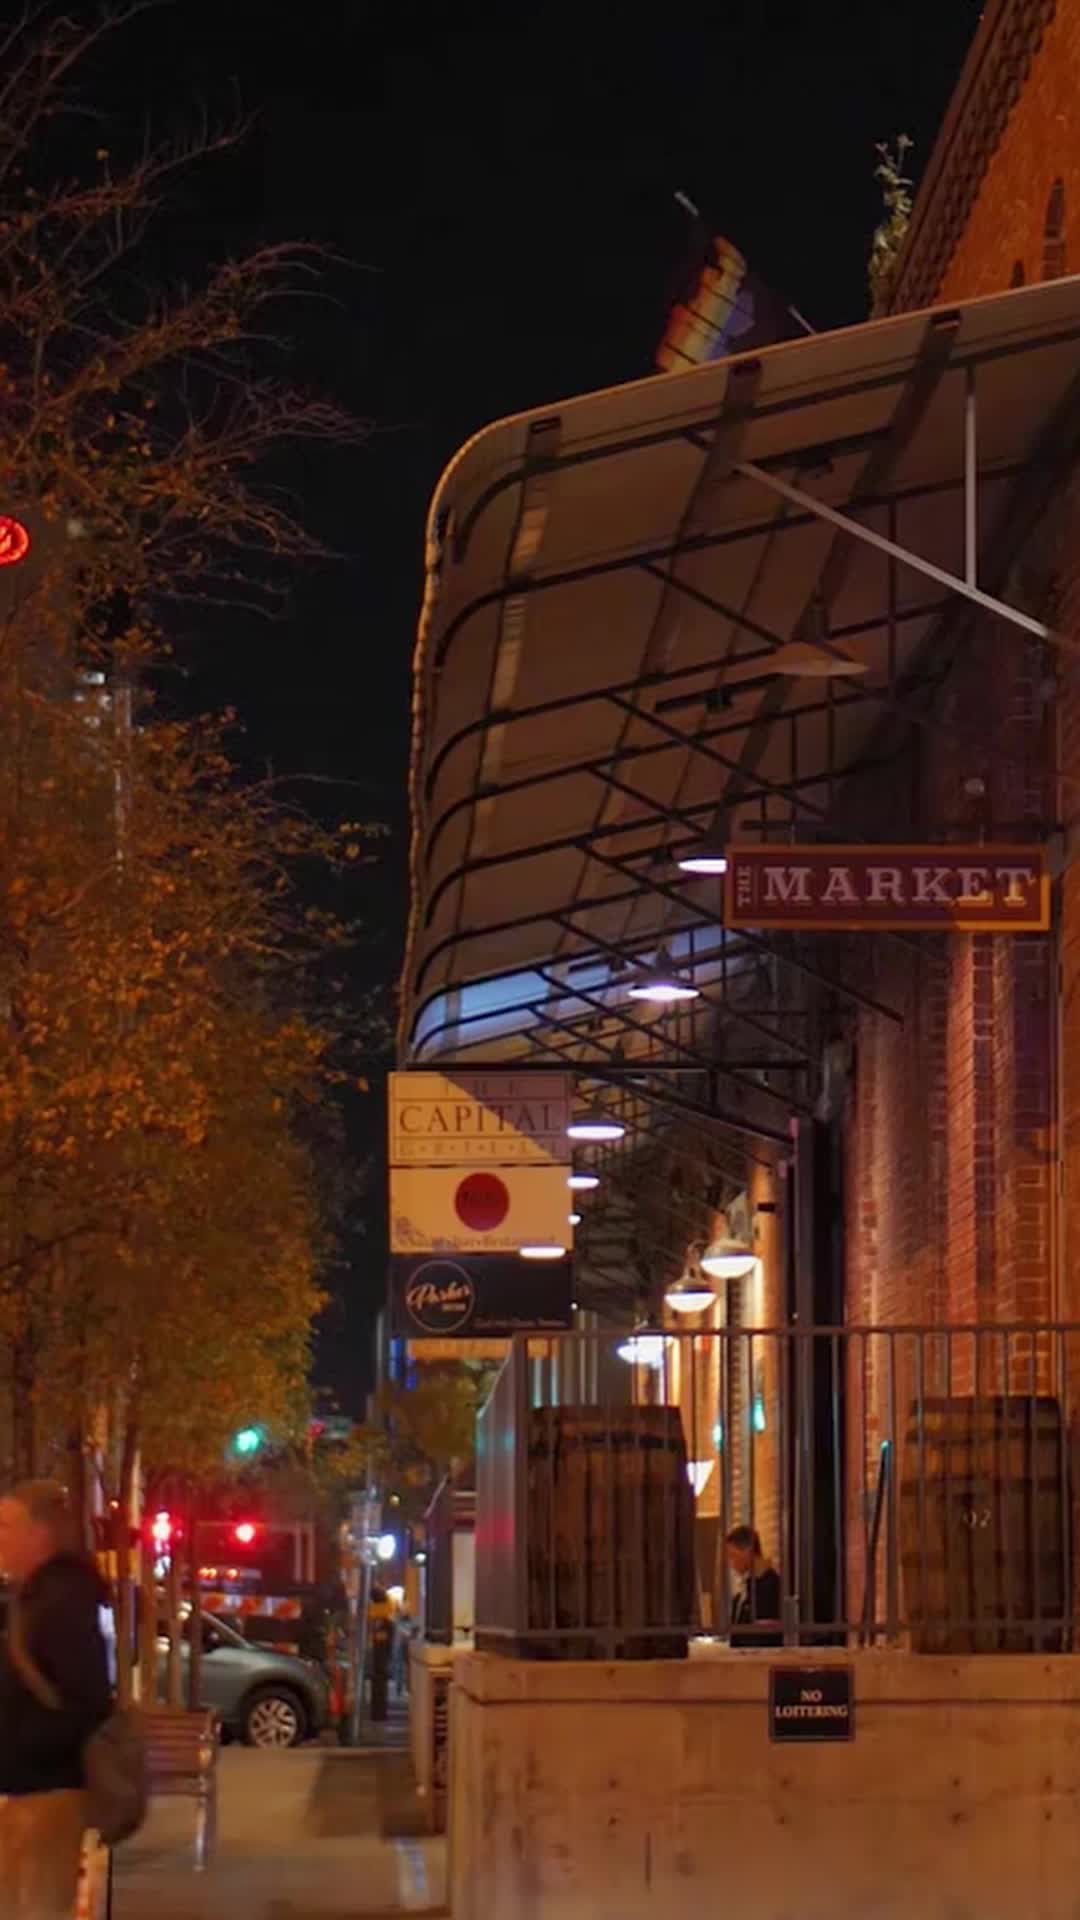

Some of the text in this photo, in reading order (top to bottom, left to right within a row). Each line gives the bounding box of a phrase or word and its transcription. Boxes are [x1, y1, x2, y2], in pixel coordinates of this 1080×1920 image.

[763, 866, 1036, 905] MARKET
[399, 1104, 559, 1133] CAPITAL
[801, 1689, 823, 1702] NO
[775, 1704, 849, 1718] LOITERING
